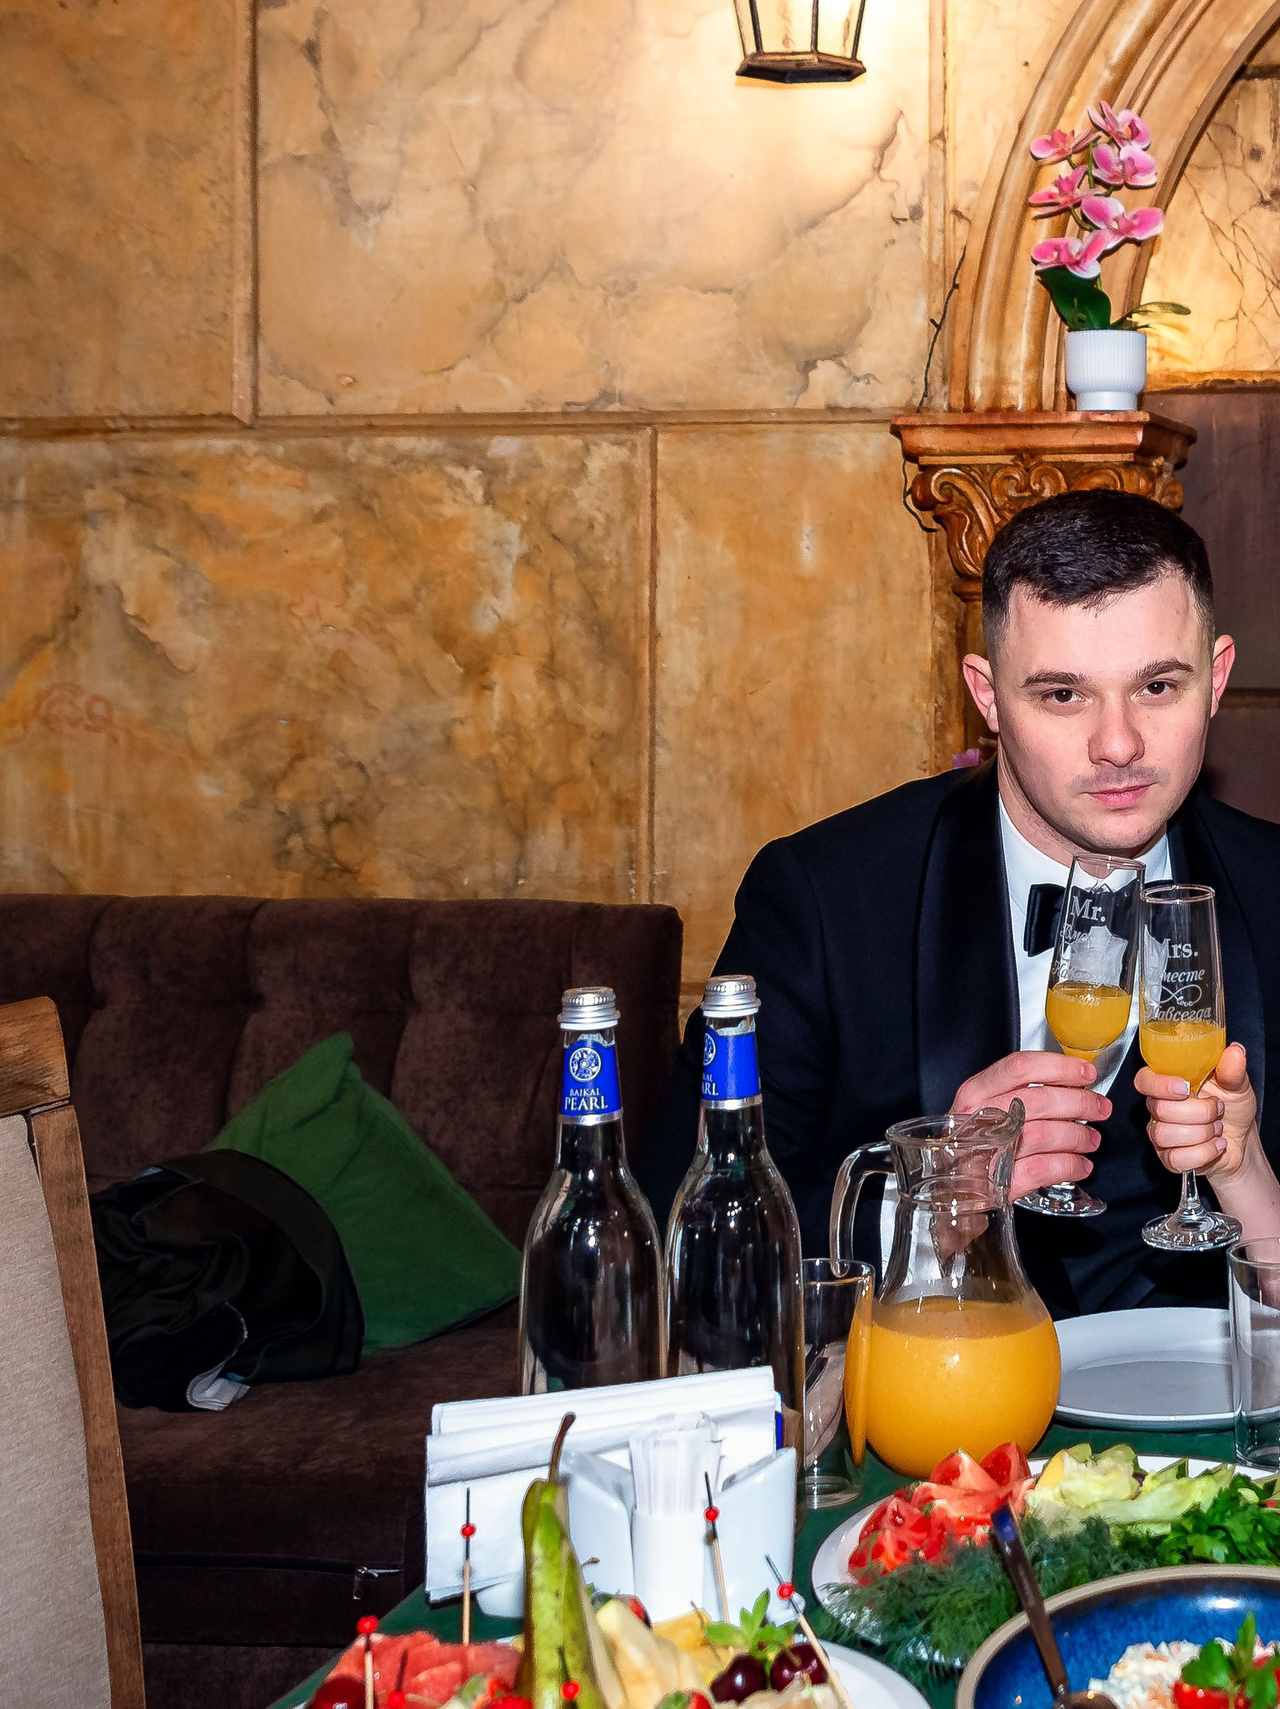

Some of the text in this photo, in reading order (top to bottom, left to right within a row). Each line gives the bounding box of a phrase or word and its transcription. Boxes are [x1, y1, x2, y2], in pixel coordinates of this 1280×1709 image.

[1070, 895, 1106, 922] Mr.
[569, 1087, 601, 1096] BAIKAL
[564, 1095, 609, 1112] PEARL
